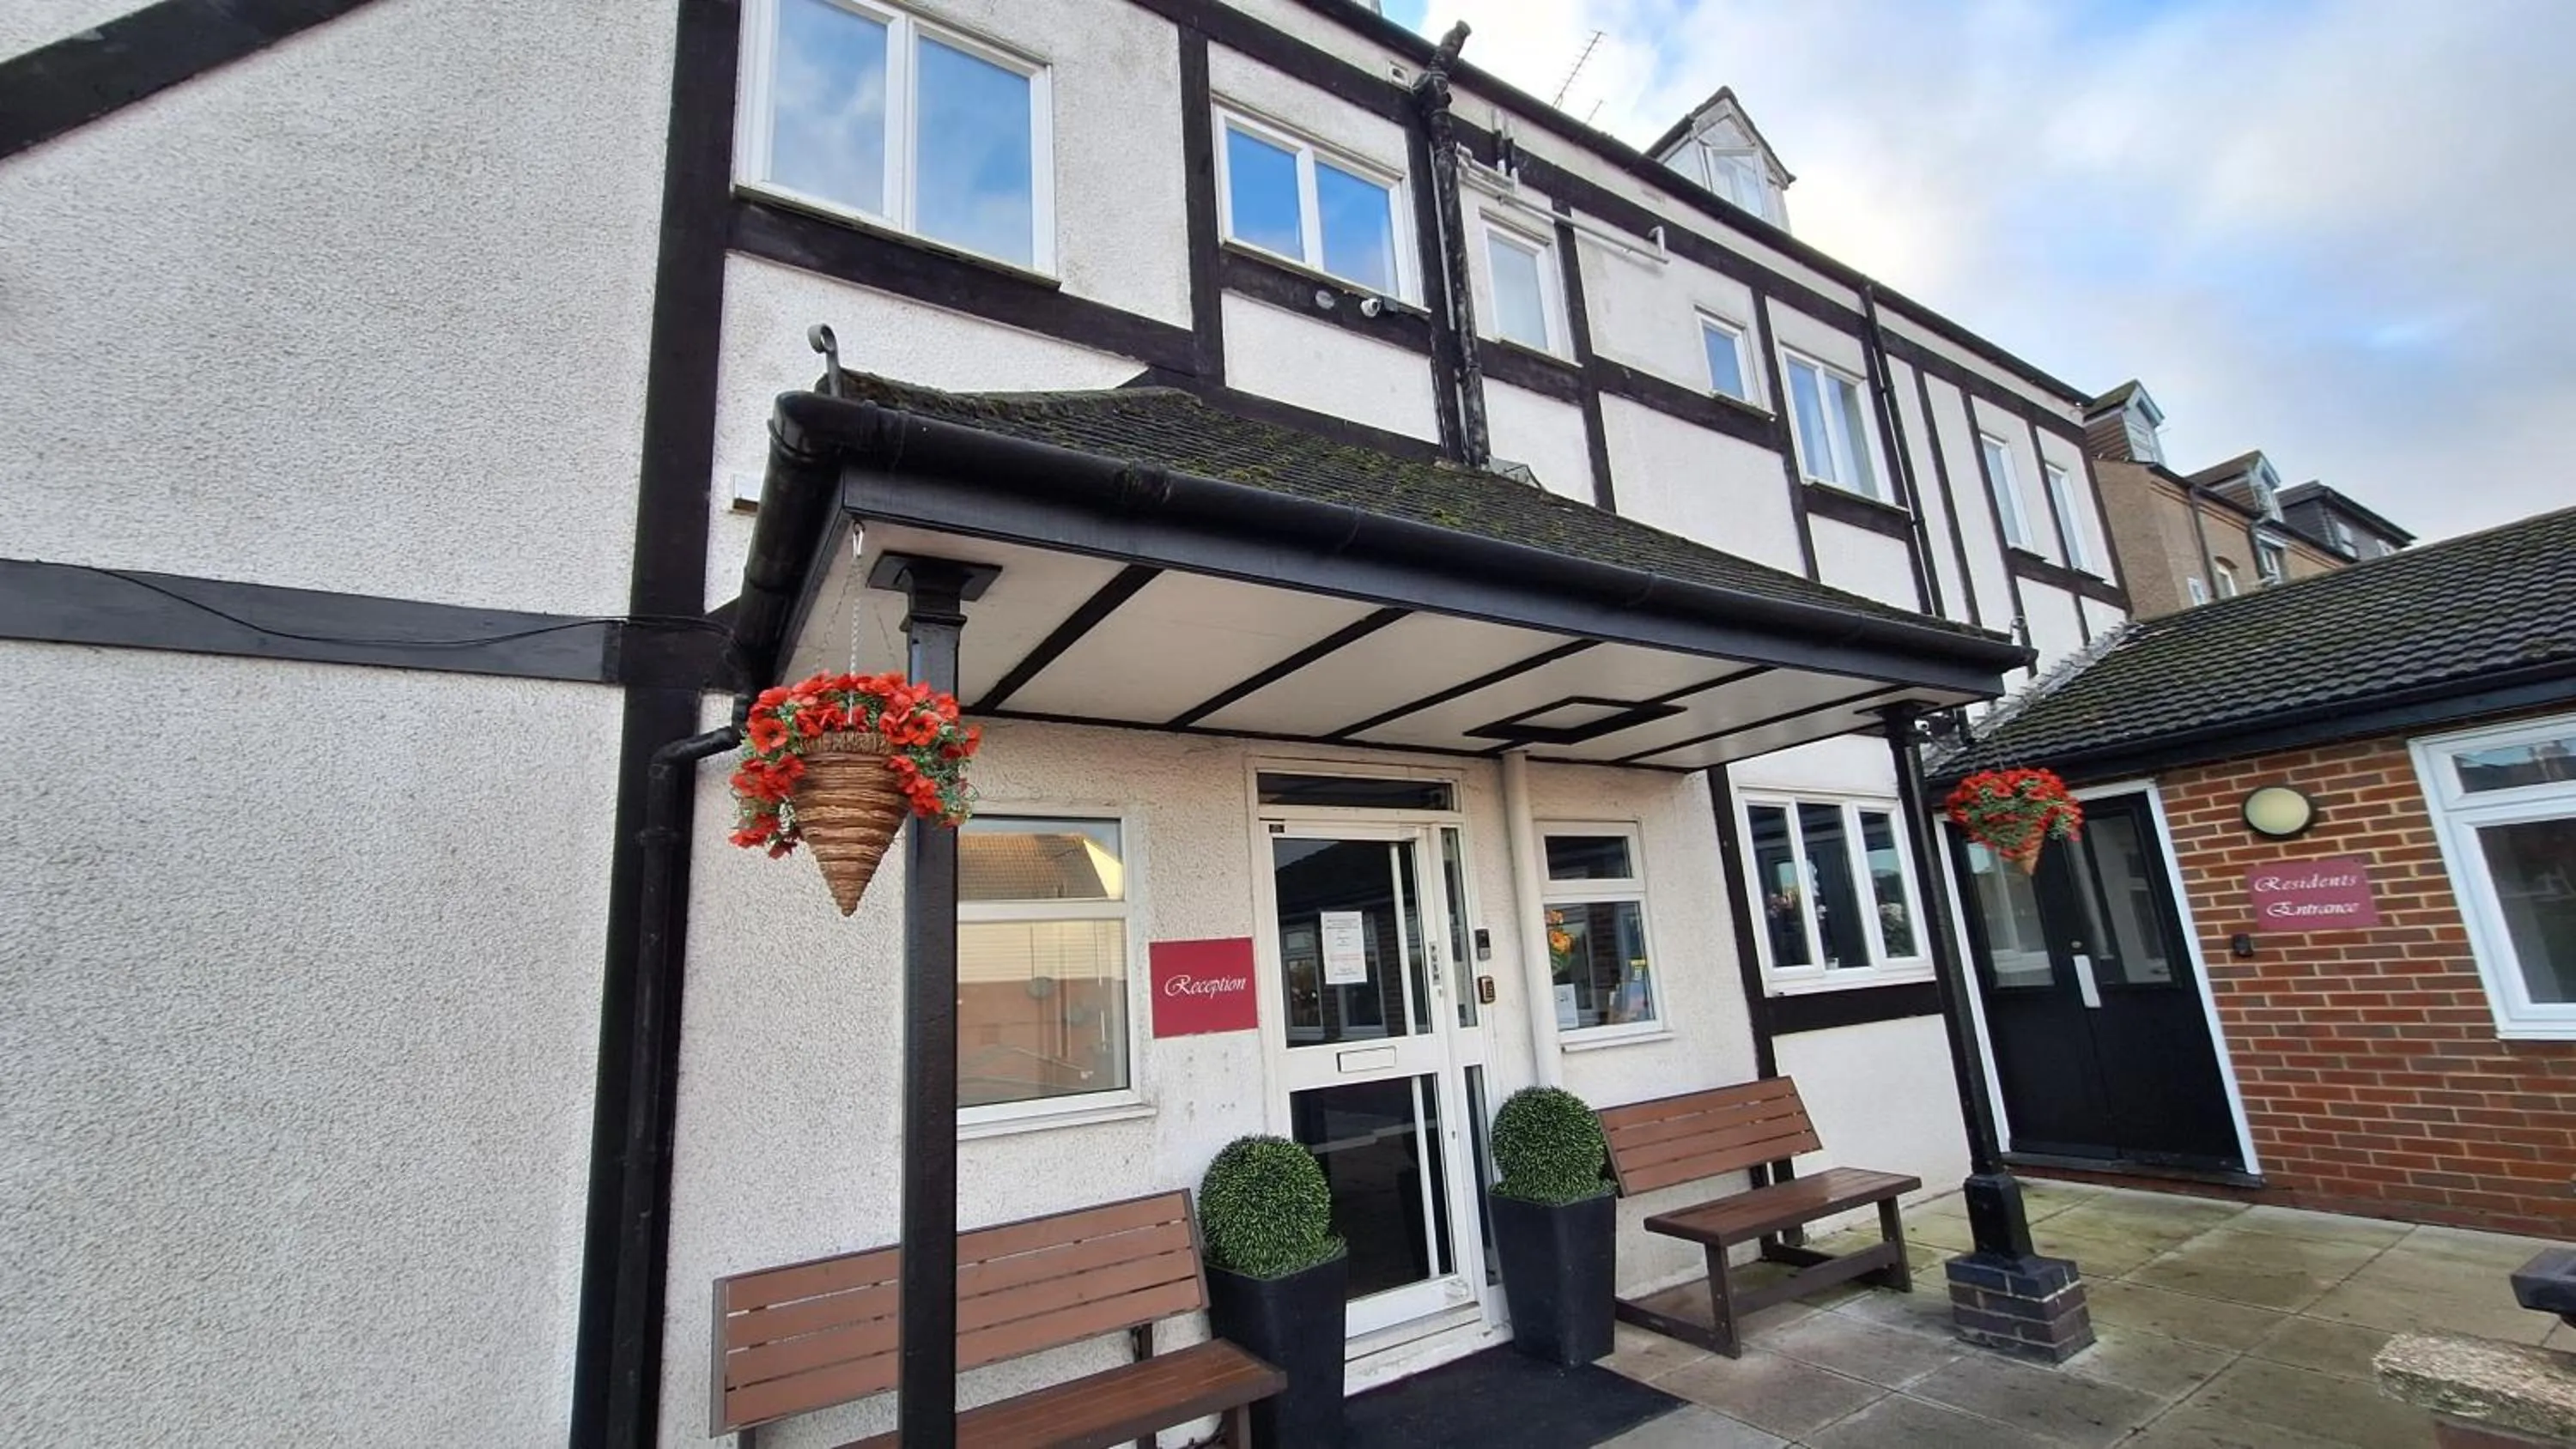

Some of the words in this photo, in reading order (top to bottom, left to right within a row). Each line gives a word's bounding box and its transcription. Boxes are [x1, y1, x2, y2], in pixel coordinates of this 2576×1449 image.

[2254, 873, 2358, 892] Residents
[2267, 901, 2360, 918] Entrance
[1164, 974, 1246, 999] Reception
